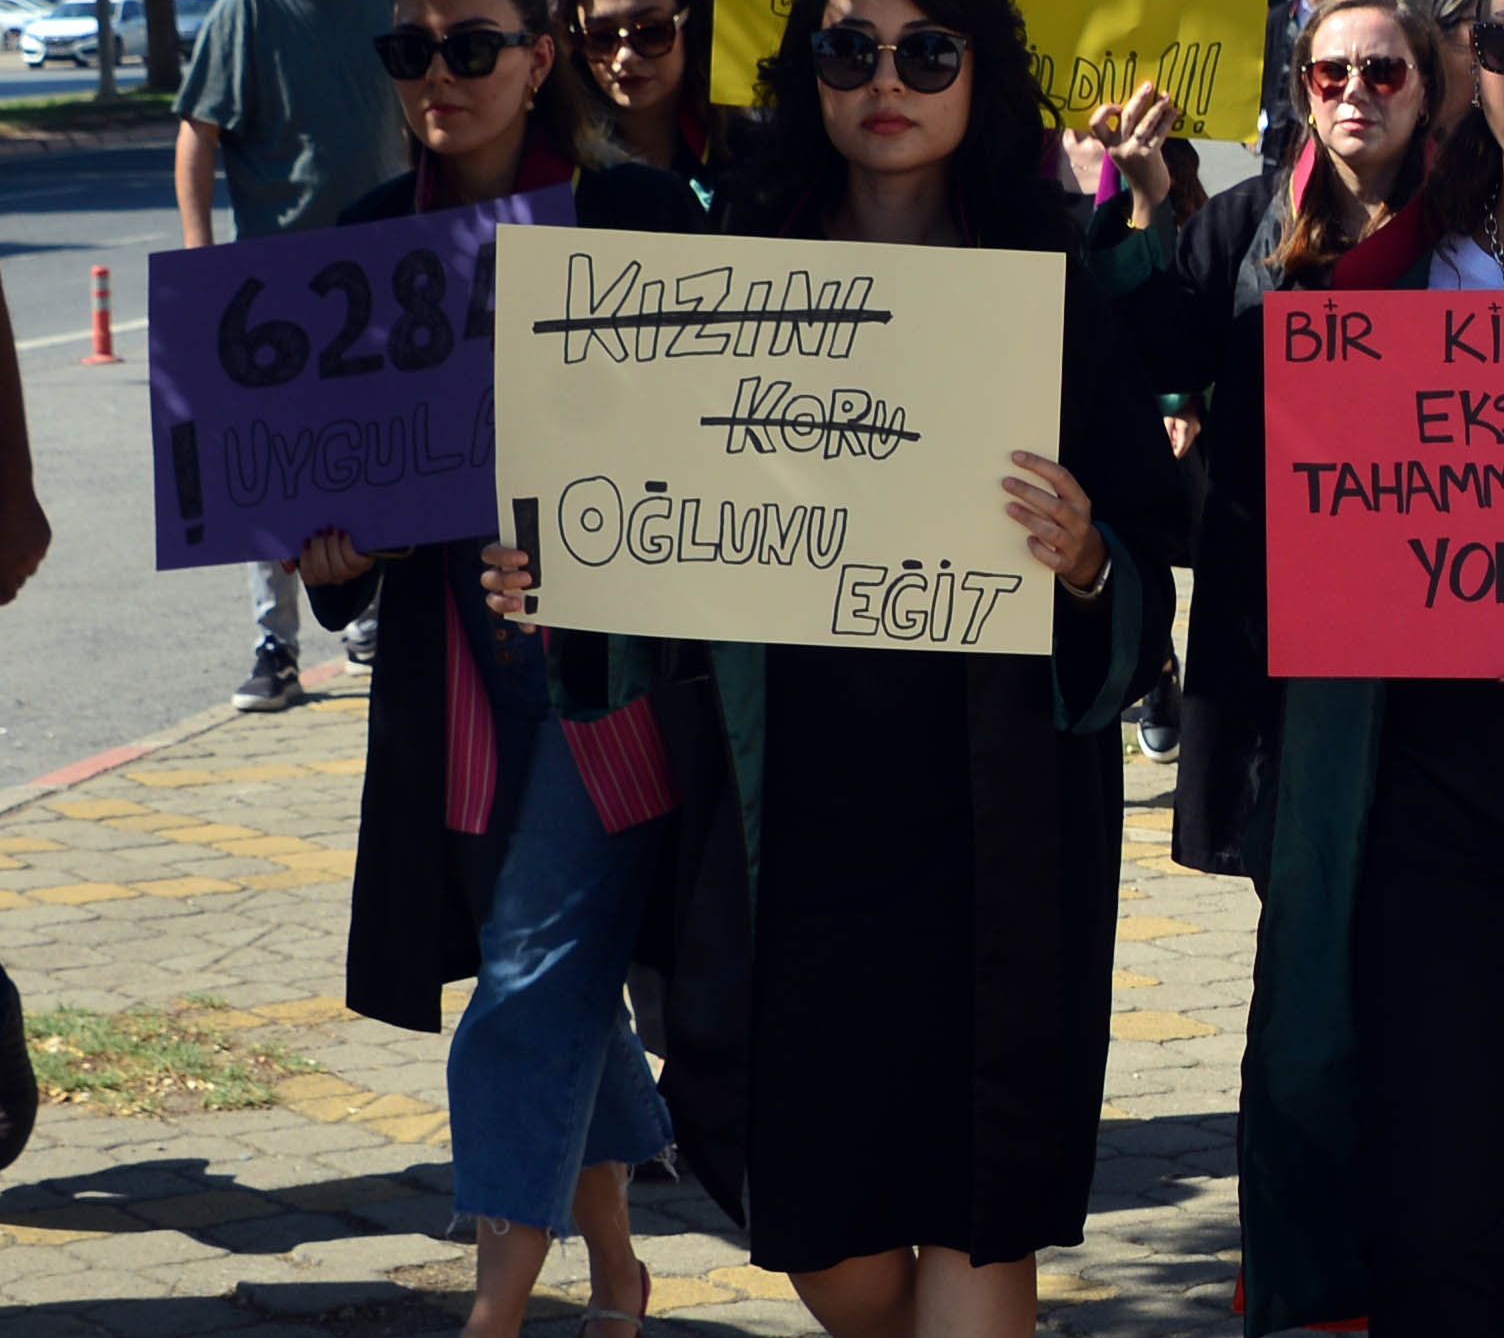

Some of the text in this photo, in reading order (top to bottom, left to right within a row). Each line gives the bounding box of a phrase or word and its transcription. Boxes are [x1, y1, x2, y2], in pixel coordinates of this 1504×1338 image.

[562, 252, 875, 364] KIZINI
[1284, 297, 1383, 362] BİR
[724, 375, 907, 460] KORU
[556, 474, 849, 570] OĞLUNU
[831, 557, 1023, 645] EĞİT
